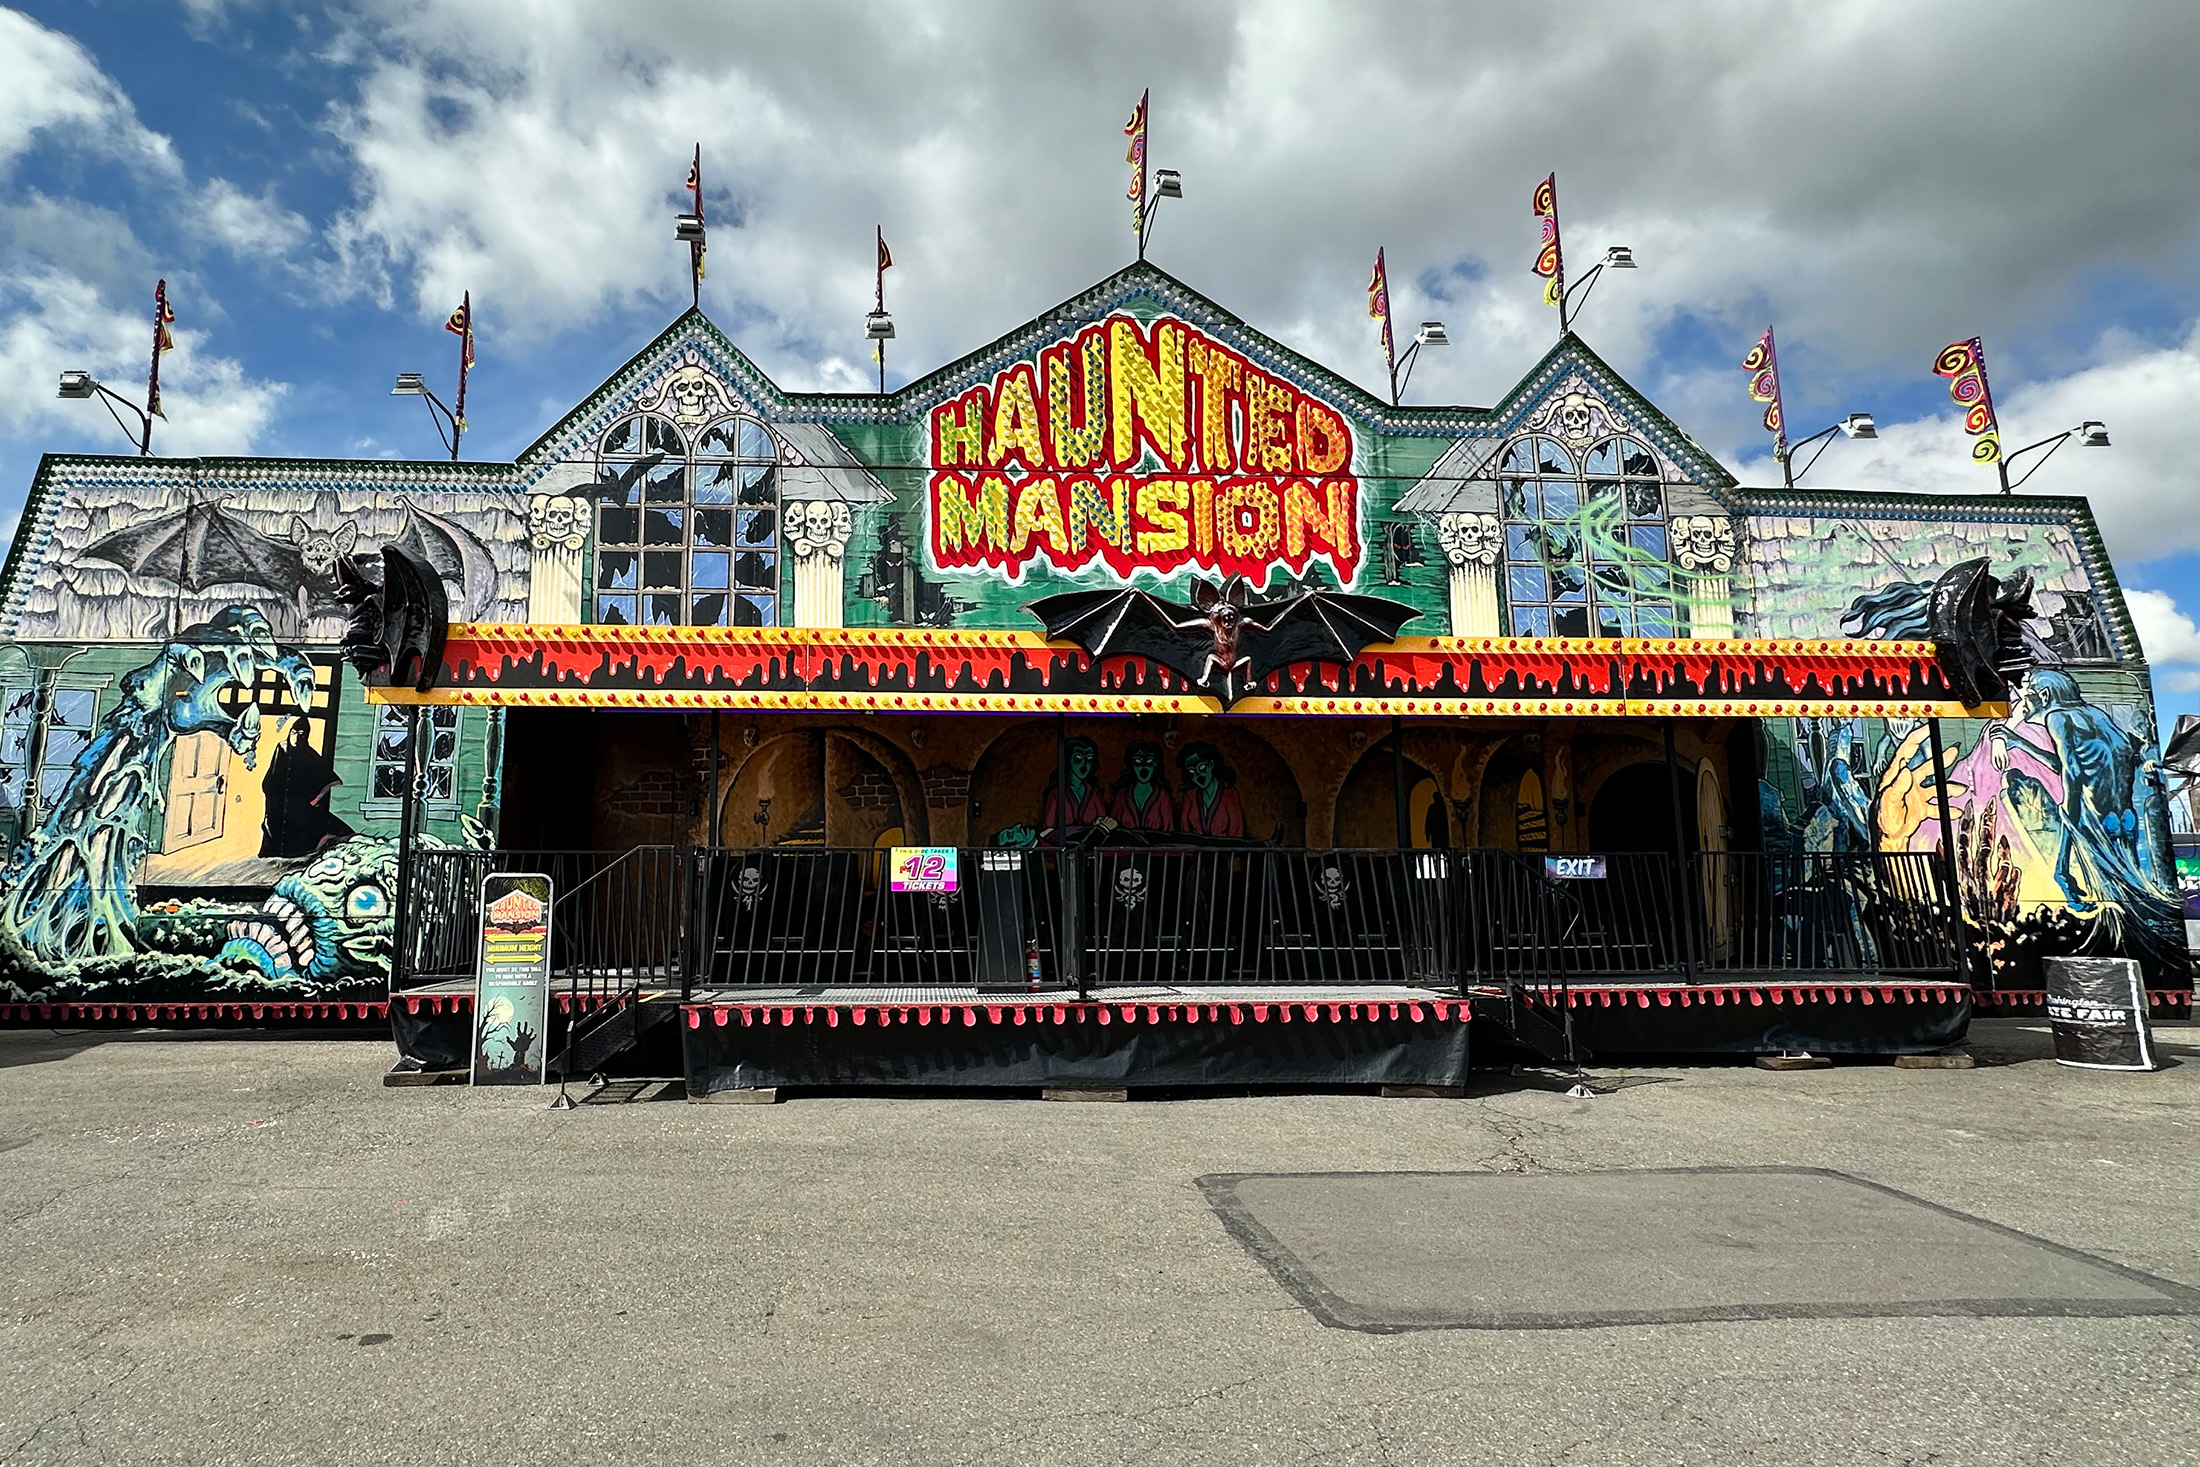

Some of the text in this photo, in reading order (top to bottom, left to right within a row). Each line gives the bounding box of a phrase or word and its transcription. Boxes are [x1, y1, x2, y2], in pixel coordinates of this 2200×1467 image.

[937, 320, 1347, 474] HAUNTED
[937, 475, 1352, 561] MANSION
[904, 855, 945, 880] 12
[1556, 858, 1596, 876] EXIT
[903, 881, 946, 890] TICKETS
[494, 895, 539, 911] HAUNTED
[493, 909, 539, 920] MANSION
[487, 943, 543, 953] MINIMUM HEIGHT
[2076, 1008, 2126, 1021] FAIR
